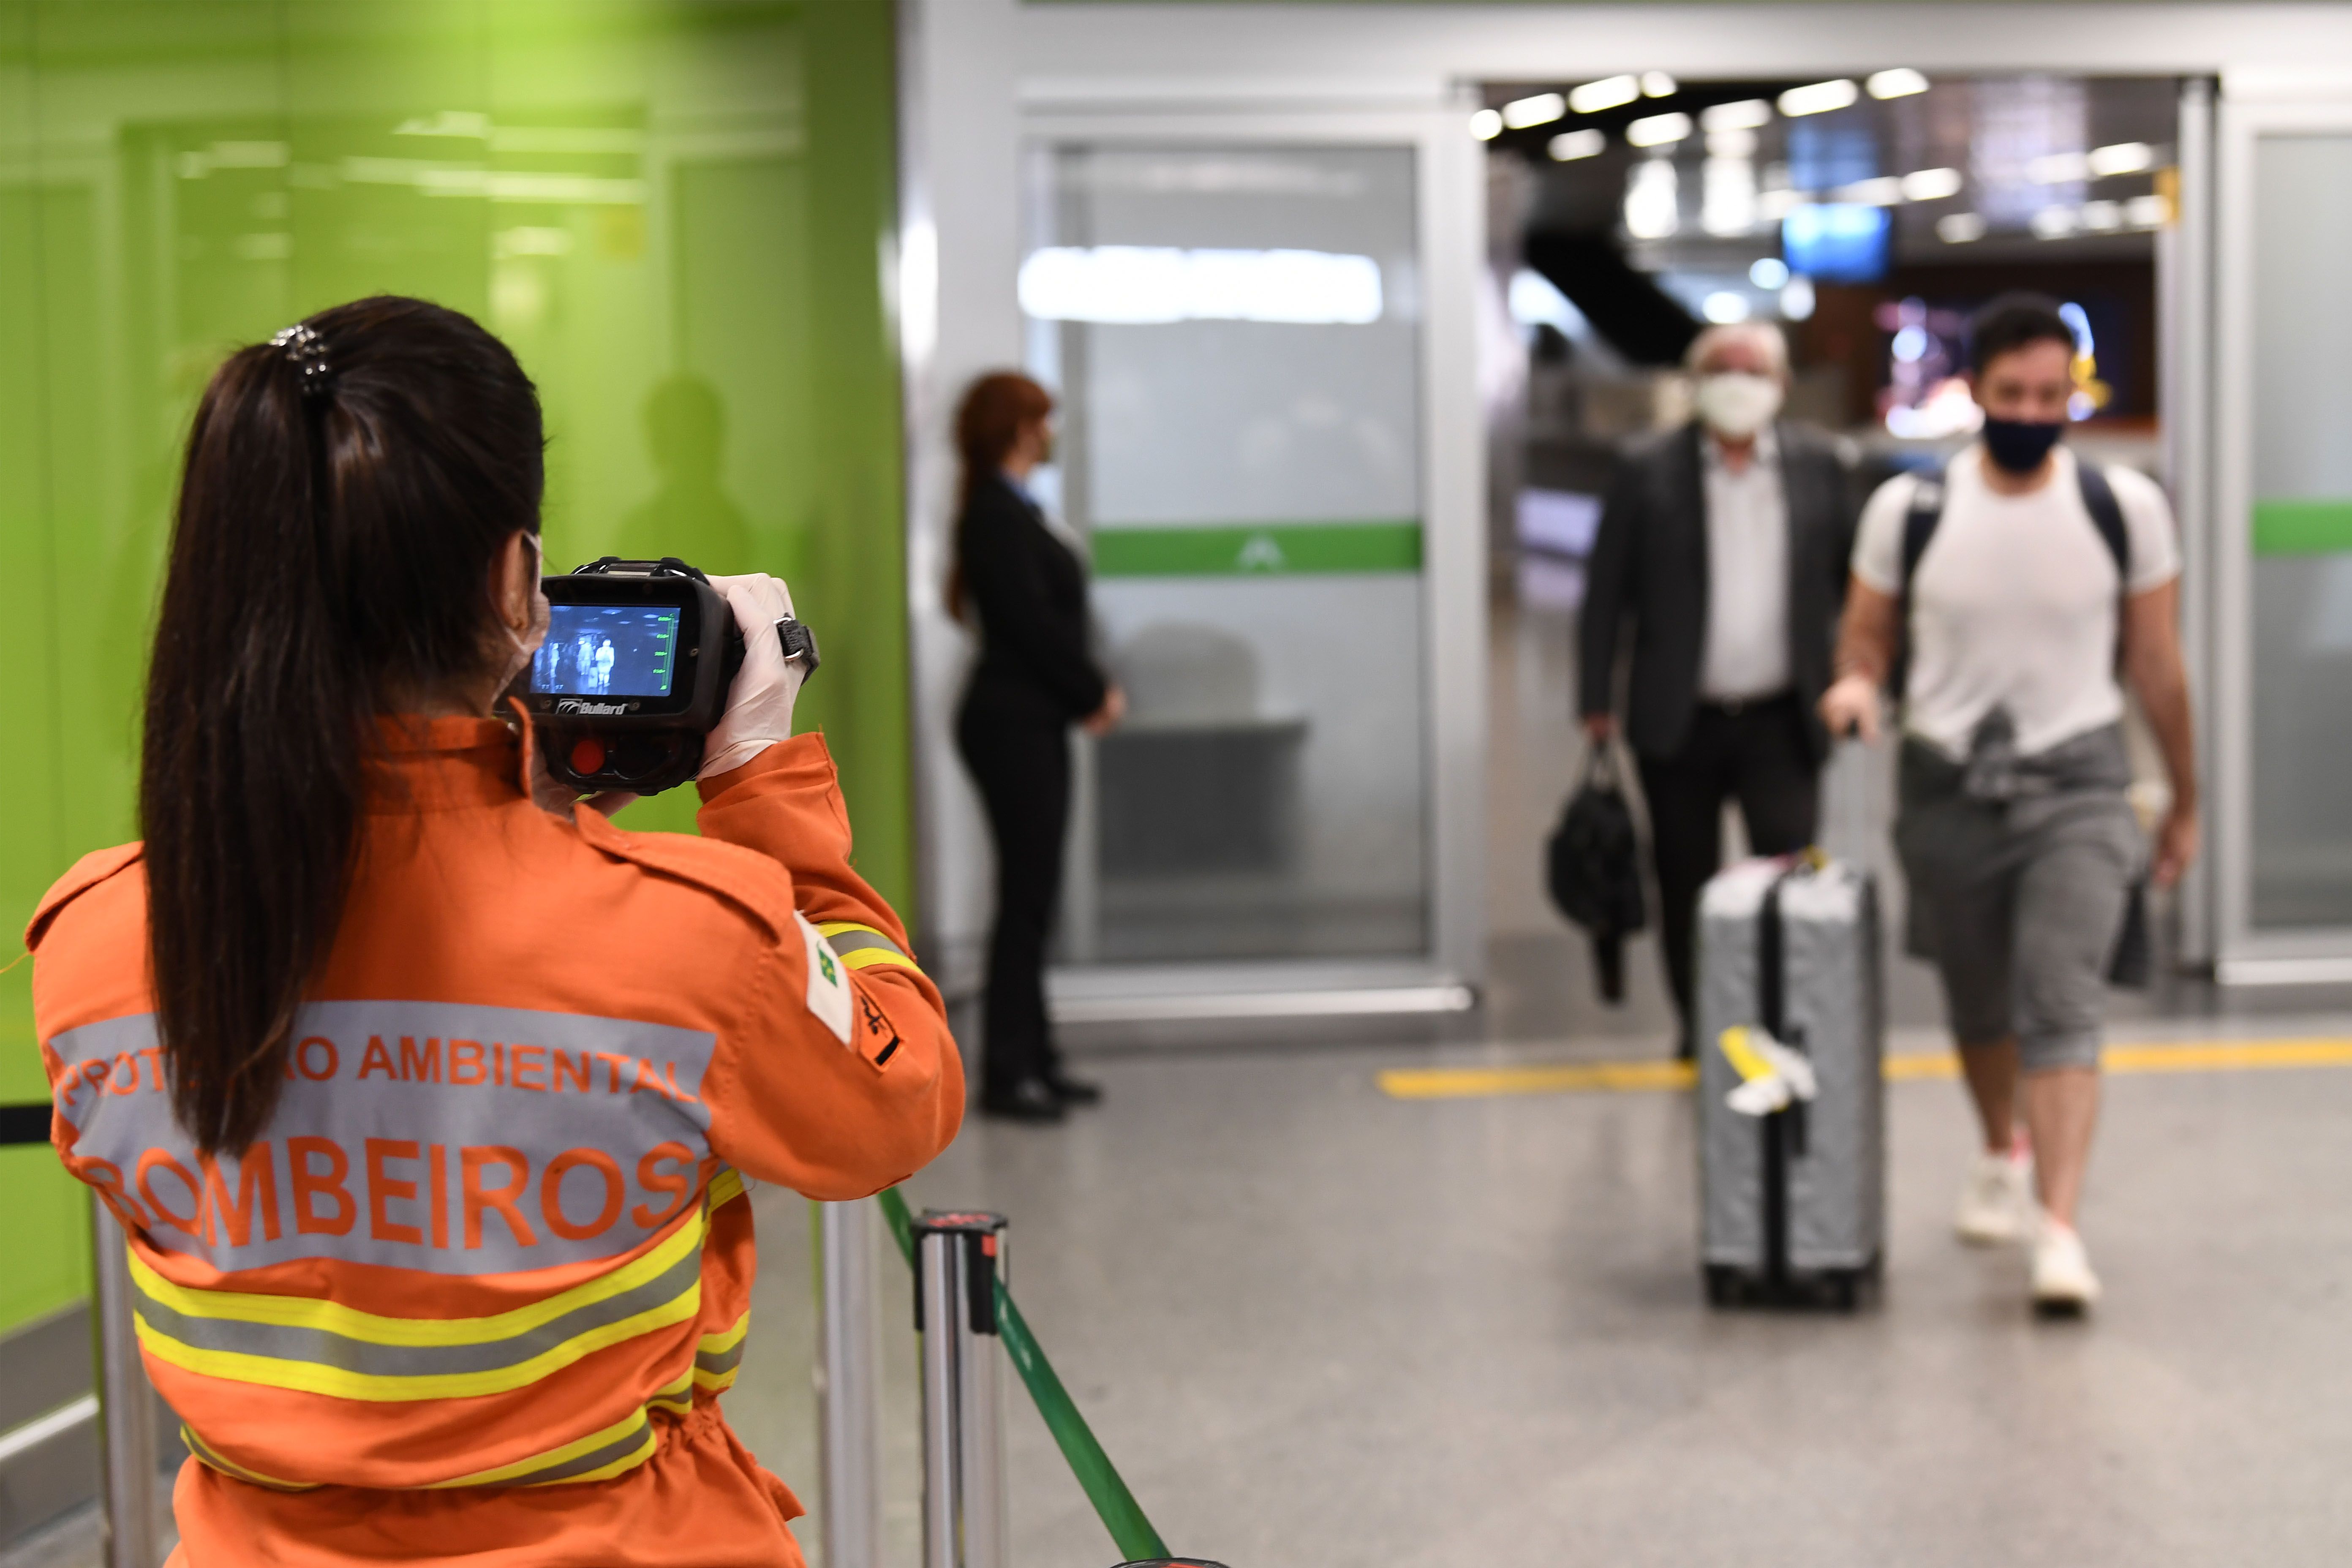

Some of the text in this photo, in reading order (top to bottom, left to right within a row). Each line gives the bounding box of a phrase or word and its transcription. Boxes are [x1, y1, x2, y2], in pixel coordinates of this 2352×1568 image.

[579, 702, 628, 715] Bullard
[62, 1035, 698, 1106] PROTO AMBIENTAL
[73, 1136, 696, 1250] BOMBEIROS
